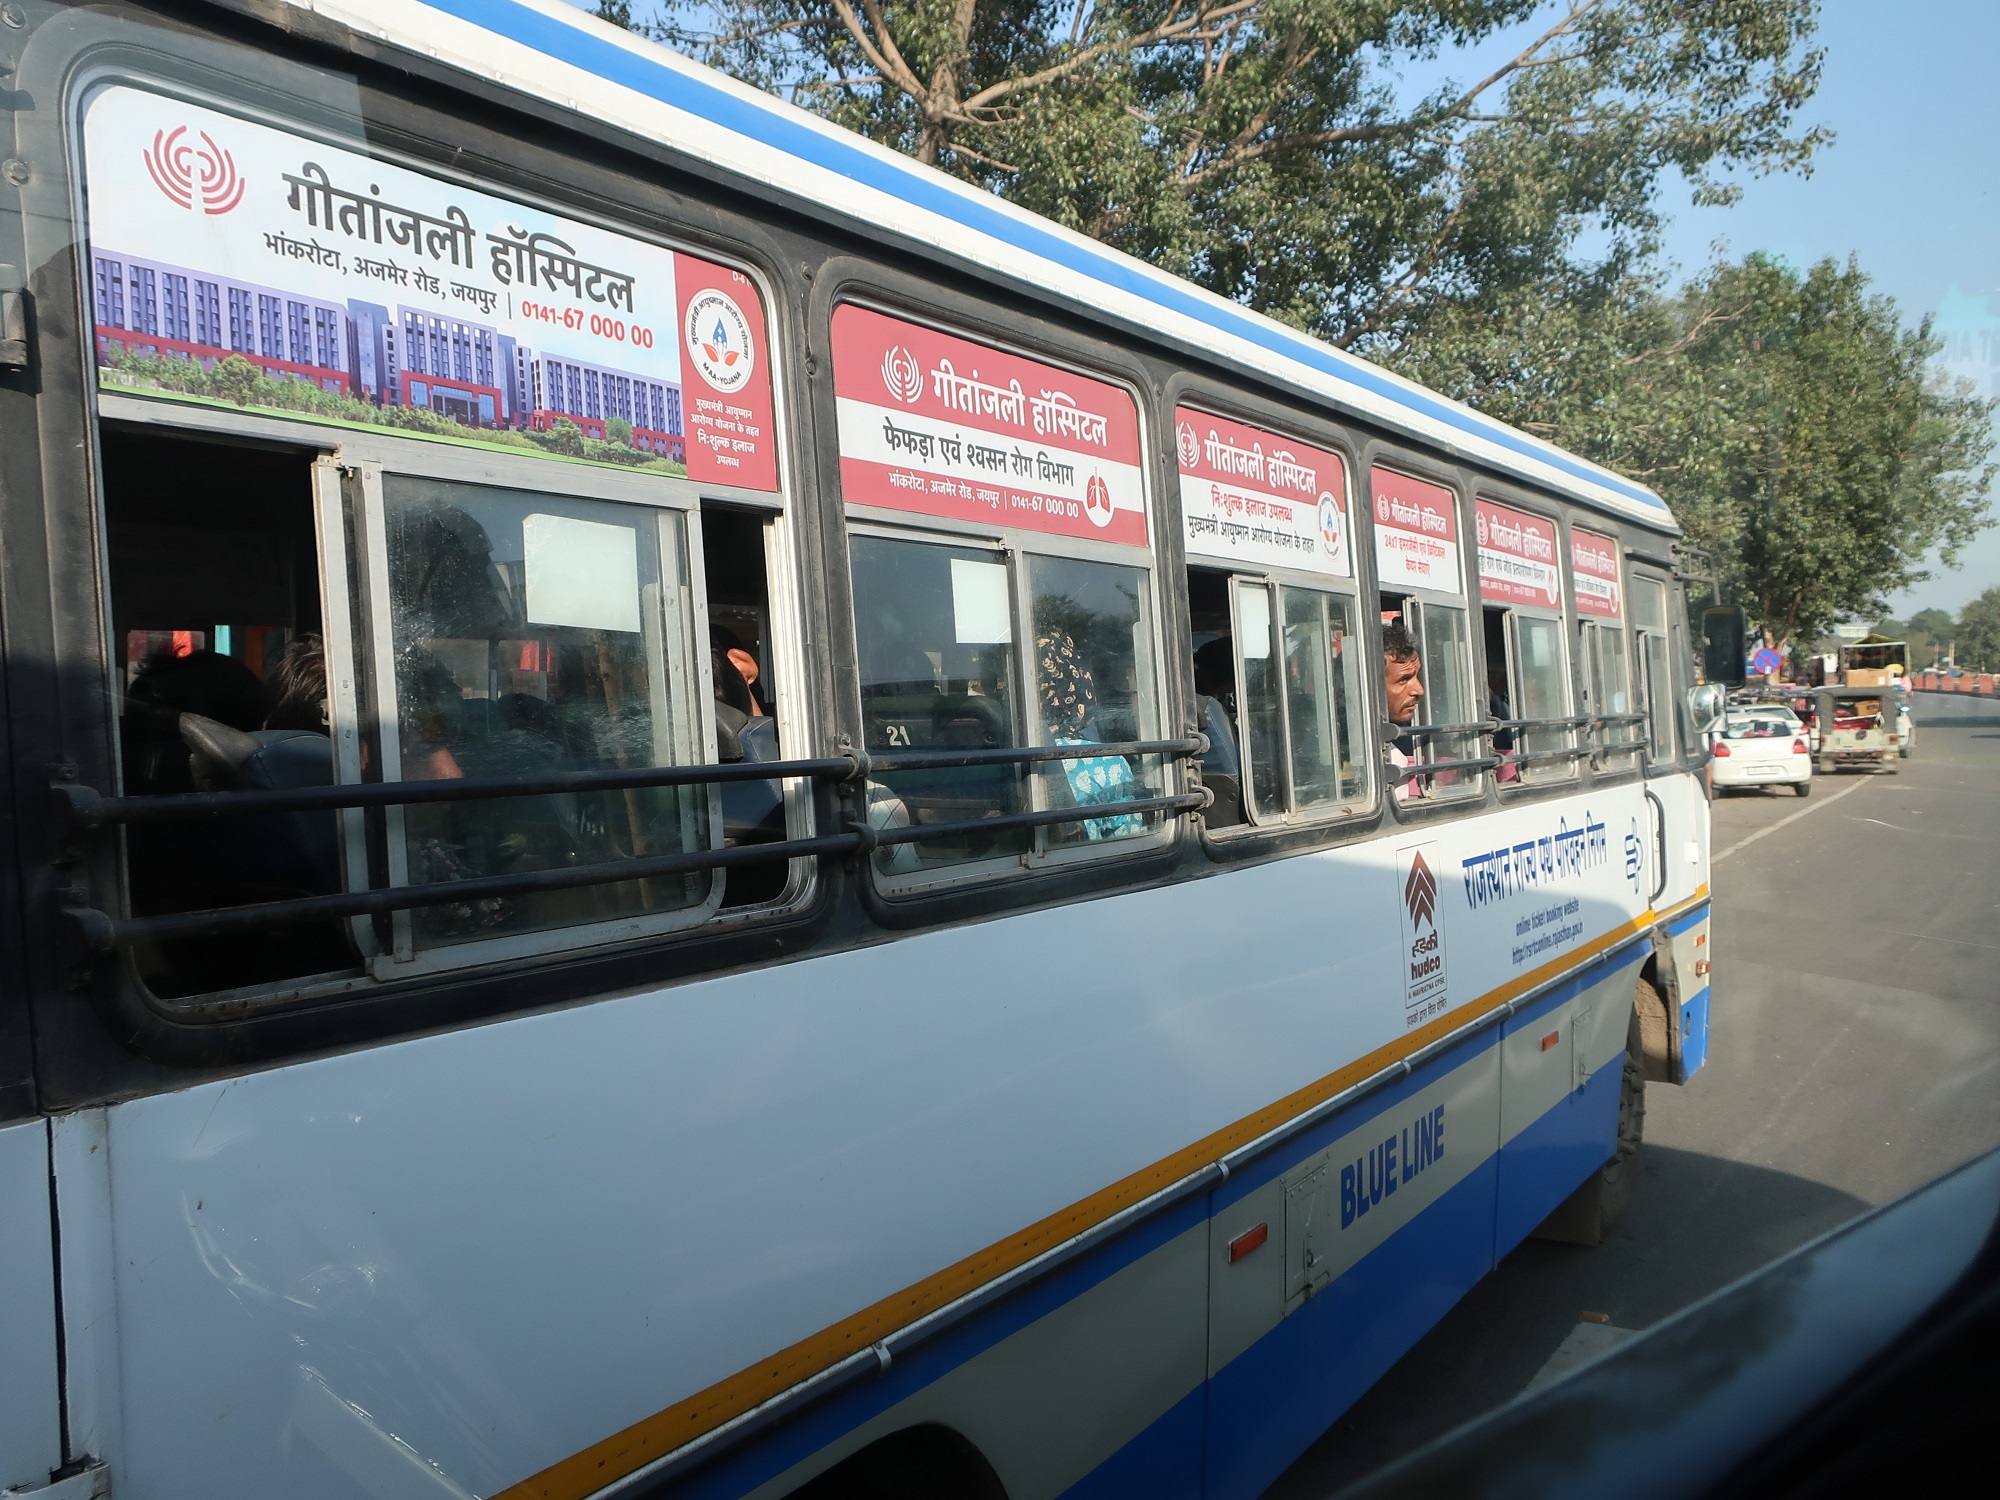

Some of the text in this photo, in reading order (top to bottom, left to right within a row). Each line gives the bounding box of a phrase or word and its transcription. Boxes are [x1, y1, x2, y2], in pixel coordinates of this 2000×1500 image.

[281, 161, 635, 313] गीतांजली हॉस्पिटल
[263, 230, 497, 314] भांकरोटा, अजमेर रोड, जयपुर
[522, 300, 653, 348] 0141-67 000 00
[703, 361, 742, 385] MAA-YOJANA
[695, 397, 753, 420] मुख्यमंत्री आयुष्मान
[930, 358, 1108, 447] गीतांजली हॉस्पिटल
[691, 412, 760, 437] आरोग्य योजना के तहत
[716, 454, 740, 467] उपलब्ध
[731, 439, 755, 454] इलाज
[883, 416, 1074, 487] फेफड़ा एवं श्वसन रोग विभाग
[1203, 429, 1317, 495] गीतांजली हॉस्पिटल
[888, 470, 1000, 509] भांकरोटा, अजमेर रोड, जयपुर
[1011, 495, 1079, 518] 0141-67 000 00
[1244, 497, 1266, 517] इलाज
[1268, 503, 1293, 523] उपलब्ध
[1391, 496, 1447, 534] गीतांजली हॉस्पिटल
[1187, 513, 1315, 553] मुख्यमंत्री आयुष्मान आरोग्य योजना के तहत
[1489, 514, 1553, 560] गीतांजली हॉस्पिटल
[886, 725, 911, 745] 21
[1462, 847, 1512, 910] राजस्थान
[1513, 840, 1539, 893] राज्य
[1554, 815, 1587, 878] परिवहन
[1586, 809, 1608, 869] निगम
[1411, 955, 1440, 980] hudco
[1341, 1103, 1445, 1230] BLUE LINE
